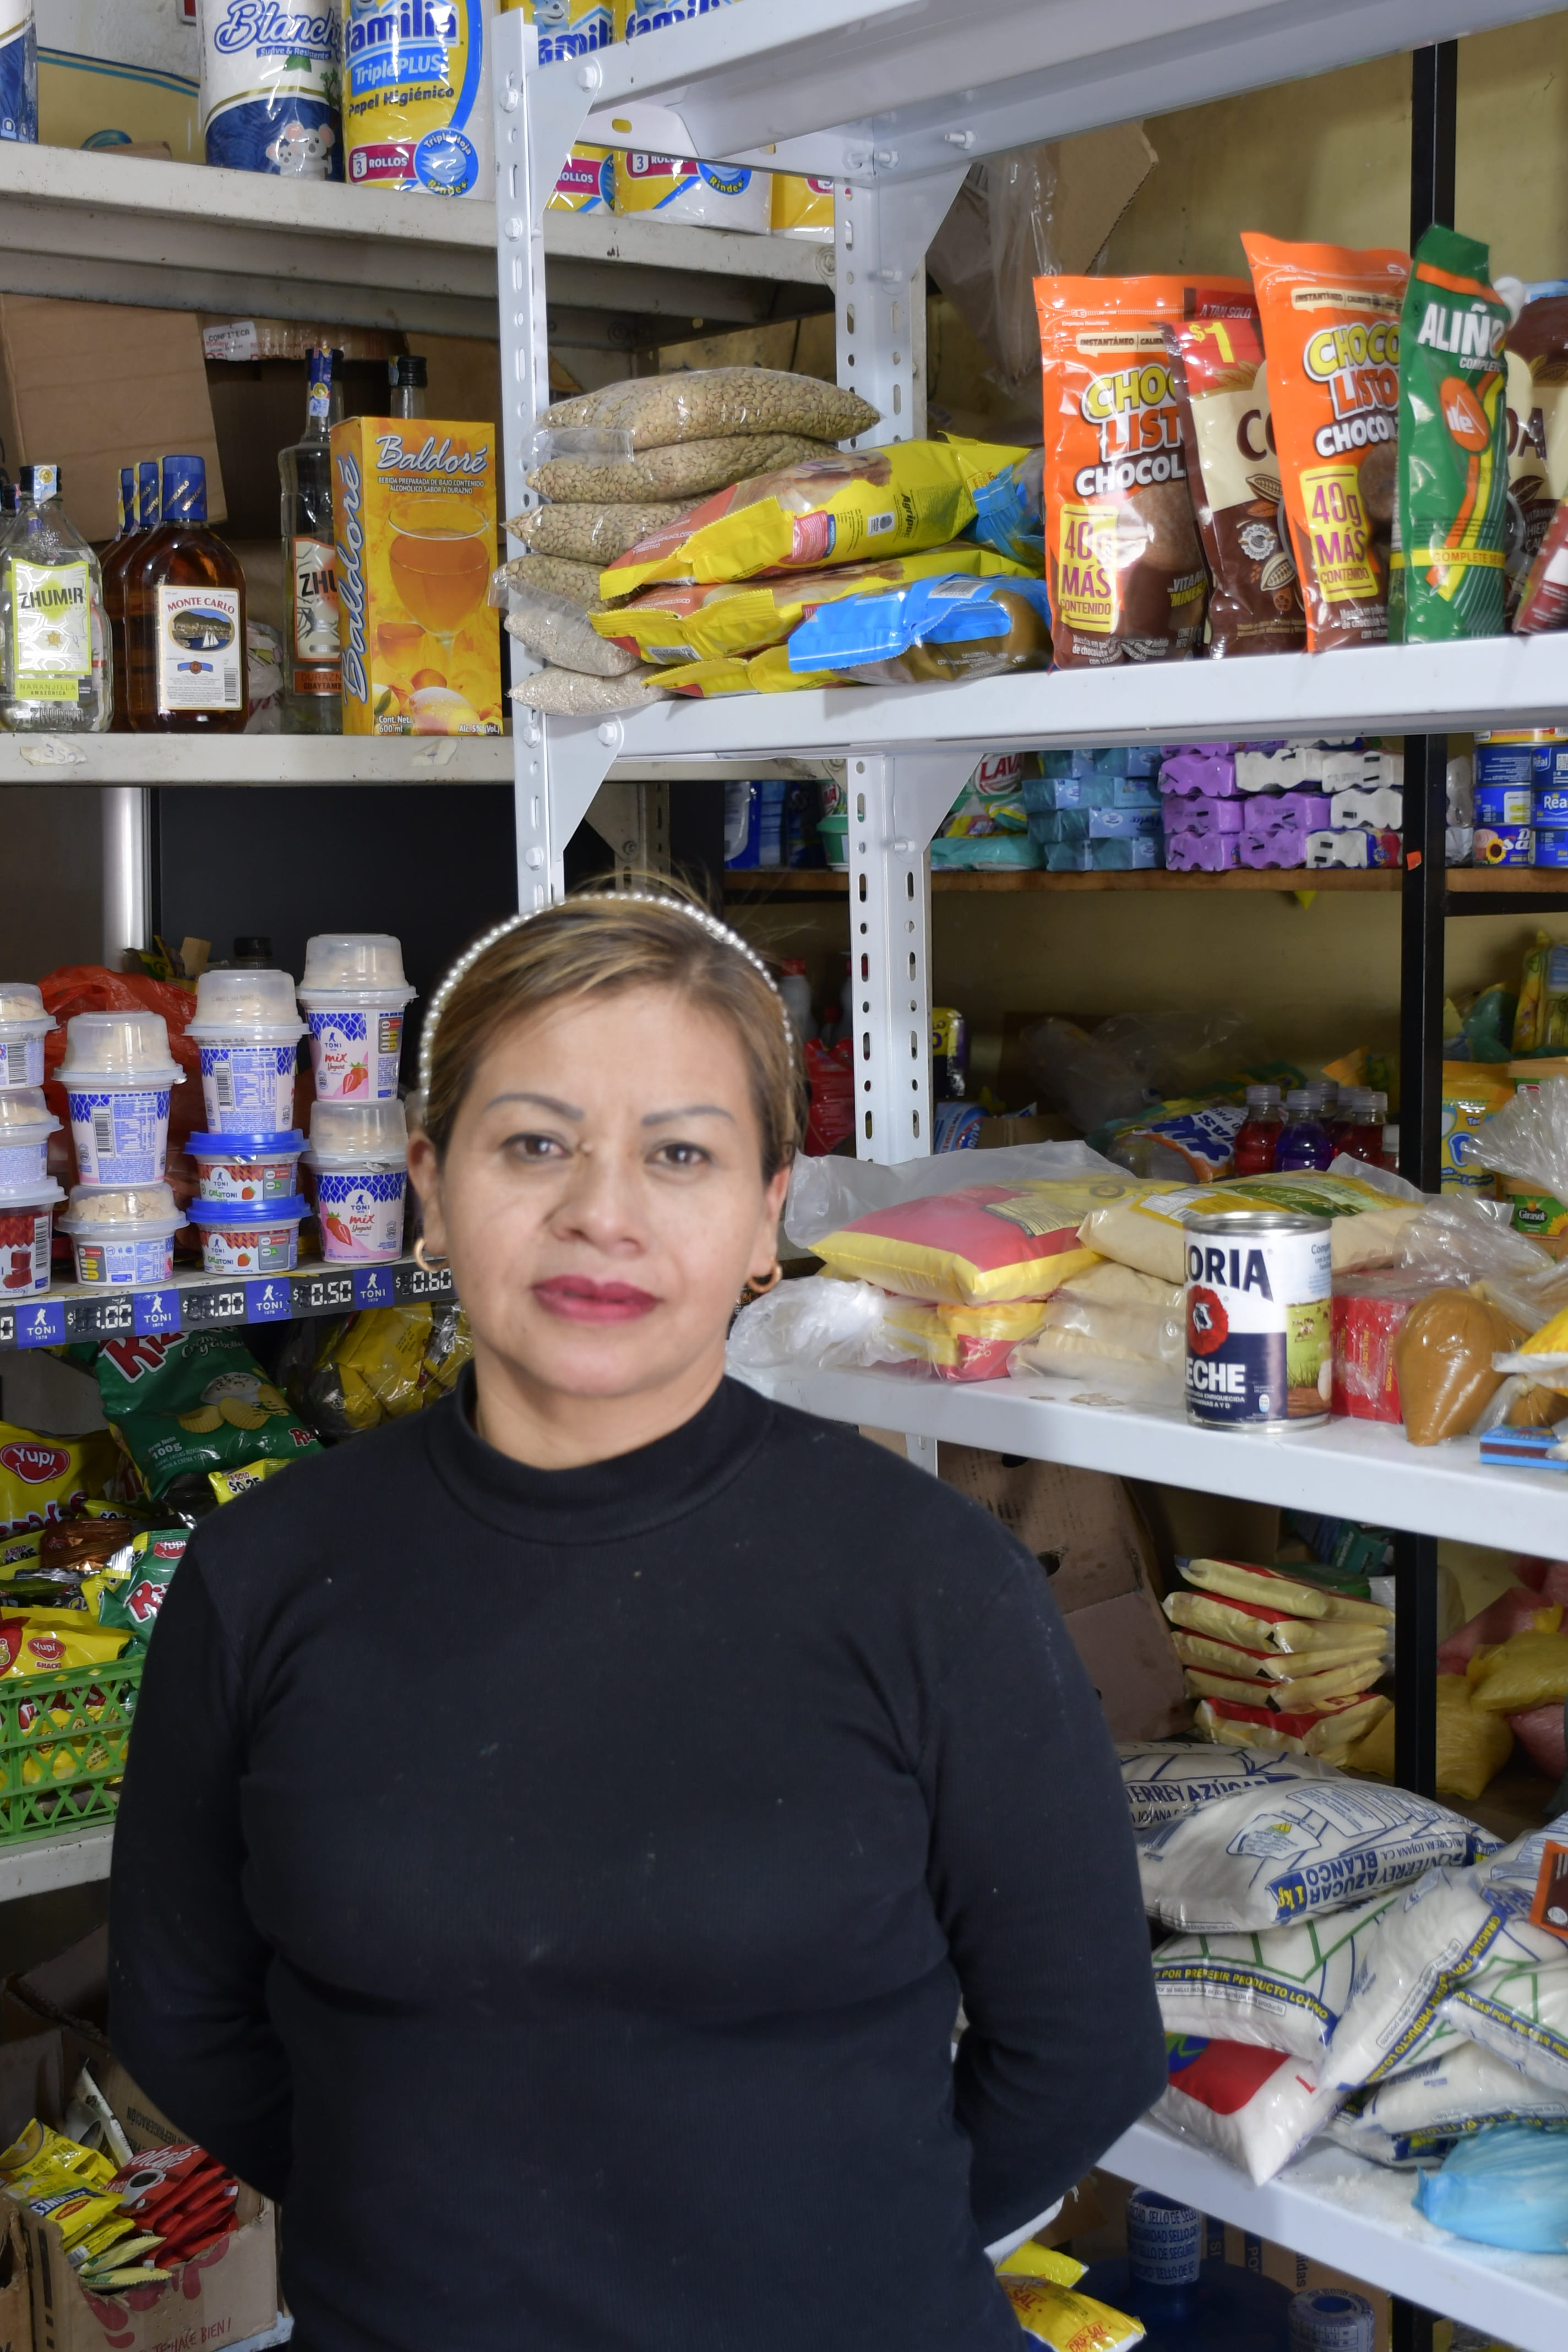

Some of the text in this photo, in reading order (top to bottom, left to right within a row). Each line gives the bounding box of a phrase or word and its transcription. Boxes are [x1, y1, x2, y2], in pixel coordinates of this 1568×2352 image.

[260, 47, 285, 57] Suave
[294, 47, 330, 59] Resistente
[355, 54, 442, 85] TriplePLUS
[349, 85, 454, 117] Papel Higiénico
[369, 157, 408, 168] ROLLOS
[1200, 304, 1252, 319] A TAN SOLO
[1080, 336, 1134, 346] INSTANTÁNEO
[1189, 322, 1234, 363] $1
[1087, 366, 1176, 418] CHO
[1333, 367, 1400, 414] LISTO
[1106, 405, 1179, 456] LIST
[375, 434, 488, 475] Baldoré
[390, 484, 423, 493] ALCOHÓLICO
[1312, 482, 1362, 527] 40g
[1525, 508, 1555, 523] VITAMIN
[1527, 522, 1548, 536] HIER
[1314, 527, 1366, 568] MÁS
[1432, 551, 1487, 563] COMPLETE
[336, 451, 369, 706] Baldoré
[1061, 564, 1112, 598] MÁS
[1320, 567, 1370, 584] CONTENIDO
[167, 597, 235, 614] MONTE CARLO
[1060, 599, 1111, 616] CONTENIDO
[301, 672, 341, 682] DURAZN
[20, 683, 77, 692] NARANJILLA
[379, 715, 411, 723] Cont. Net.
[325, 1053, 348, 1063] mix
[327, 1063, 345, 1071] Yogurt
[349, 1214, 375, 1224] mix
[351, 1224, 372, 1233] Yogurt
[1185, 1244, 1274, 1303] ORIA
[360, 1289, 386, 1299] TONI
[256, 1301, 282, 1311] TONI
[144, 1313, 172, 1323] TONI
[27, 1326, 56, 1336] TONI
[1185, 1356, 1246, 1394] ECHE
[1204, 1393, 1245, 1403] ENRIQUECIDA
[161, 1436, 176, 1446] Neto
[13, 1447, 56, 1469] Yupi
[152, 1441, 183, 1460] 100g
[235, 1471, 250, 1480] SOLO
[33, 1641, 56, 1652] Yupi
[1306, 1850, 1378, 1886] BLANCO
[1161, 1969, 1182, 1979] POR
[1184, 1968, 1229, 1982] PREFERIR
[1232, 1974, 1288, 1999] PRODUCTO
[201, 2317, 232, 2343] BIEN!
